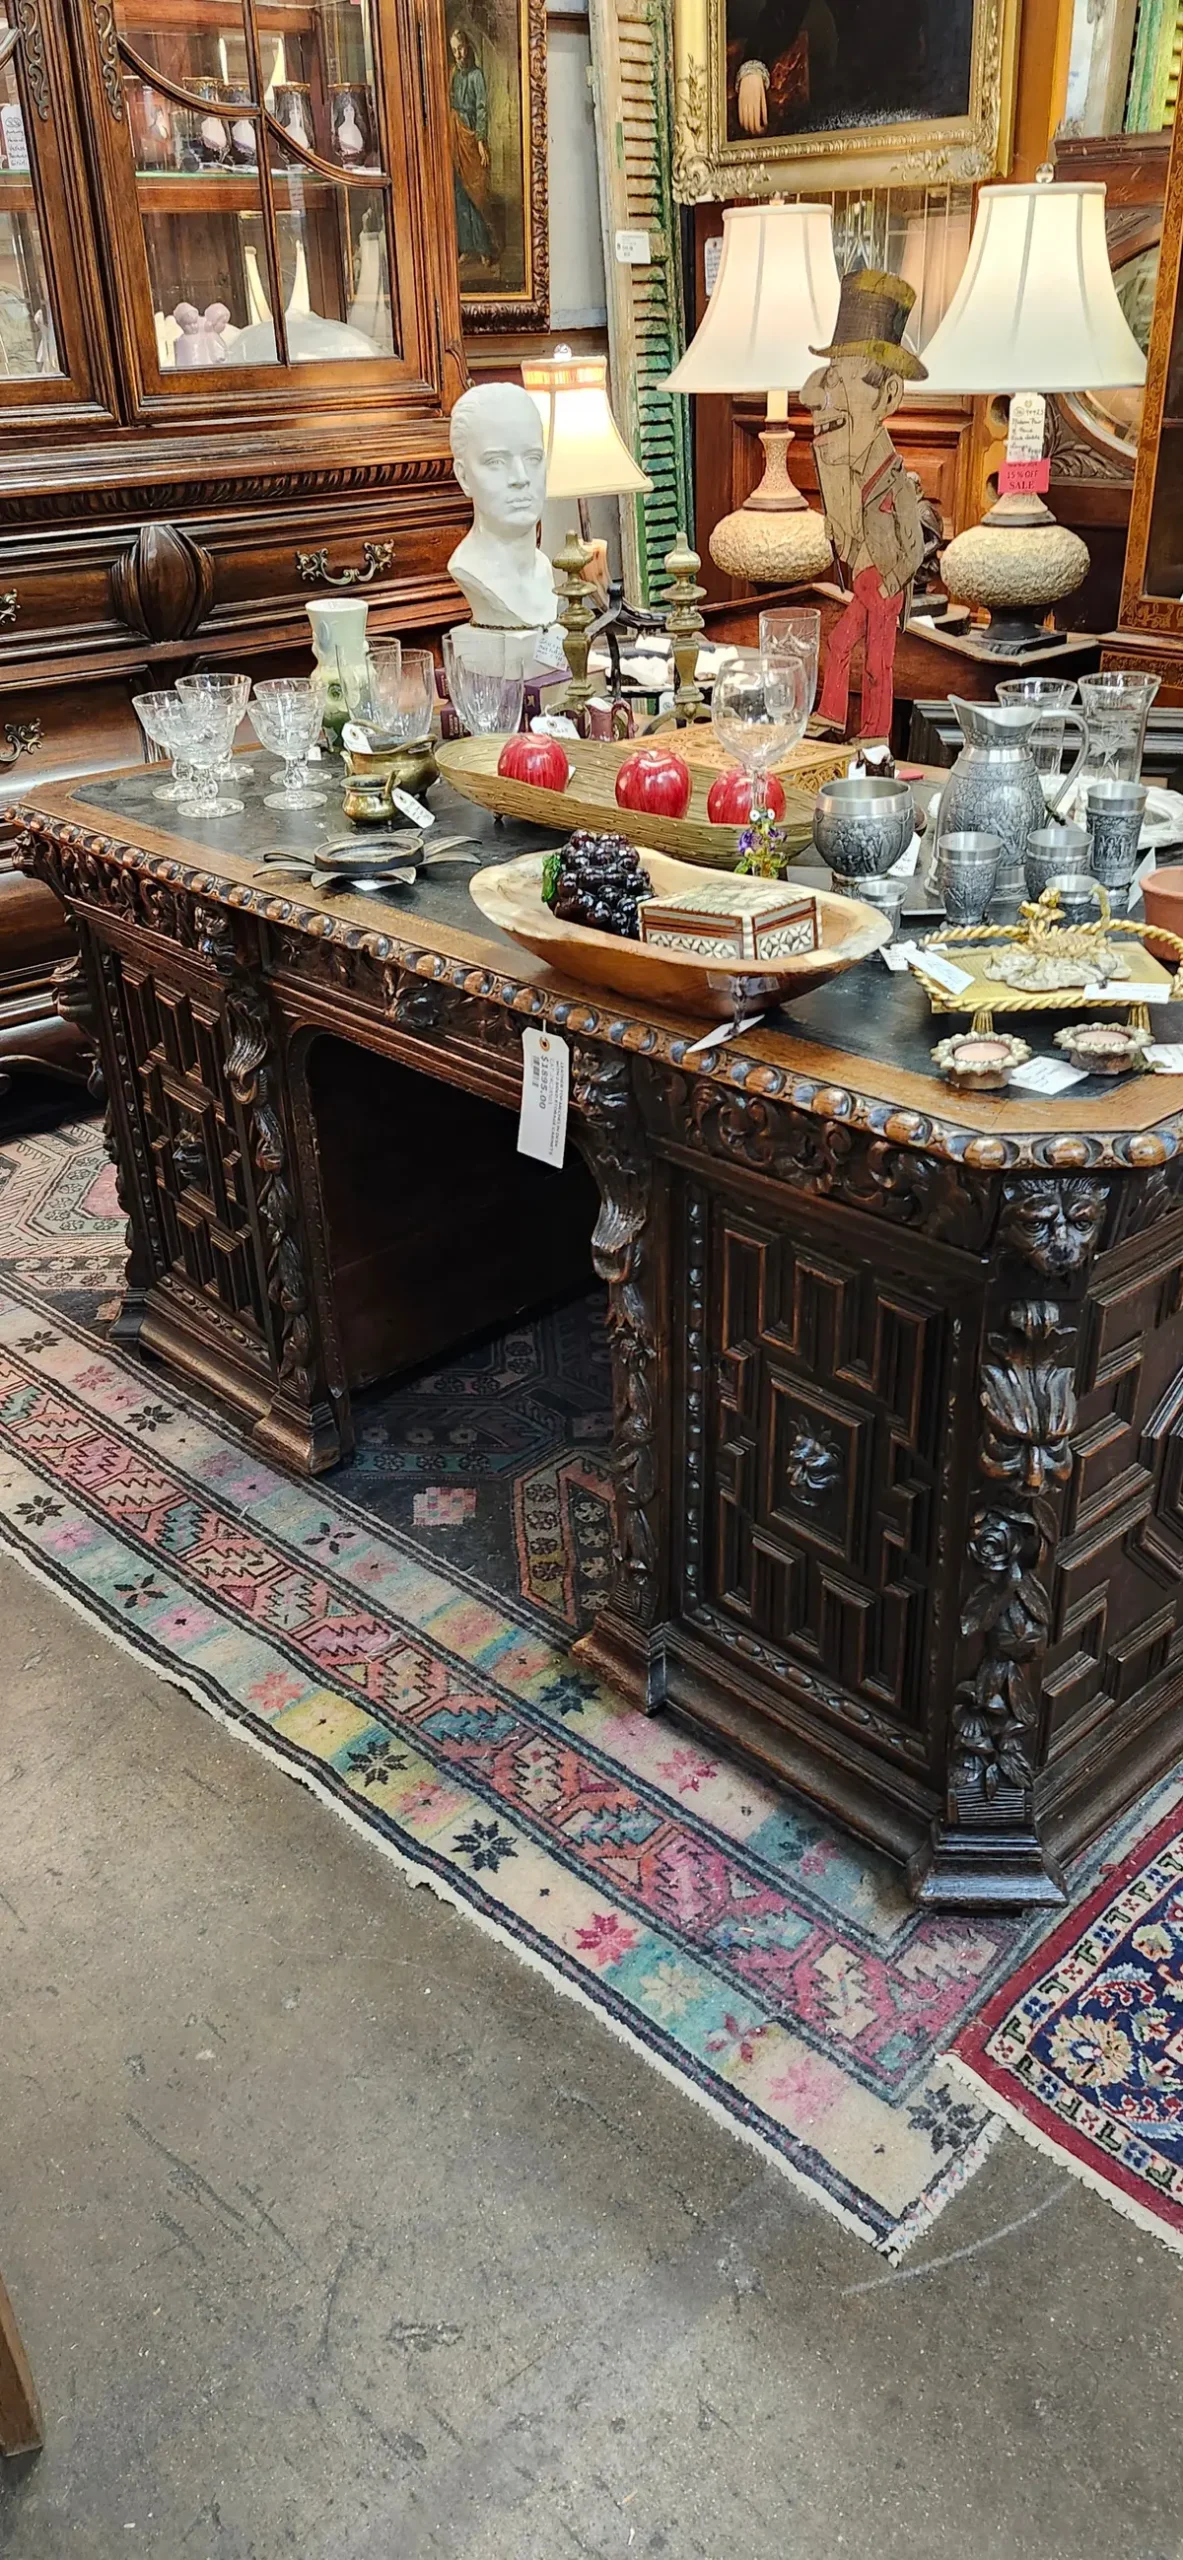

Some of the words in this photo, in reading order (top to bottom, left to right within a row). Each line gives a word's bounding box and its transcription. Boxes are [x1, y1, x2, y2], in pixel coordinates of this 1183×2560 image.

[1025, 469, 1039, 478] OFF
[1008, 481, 1035, 490] SALE
[538, 1055, 549, 1109] $1895.00
